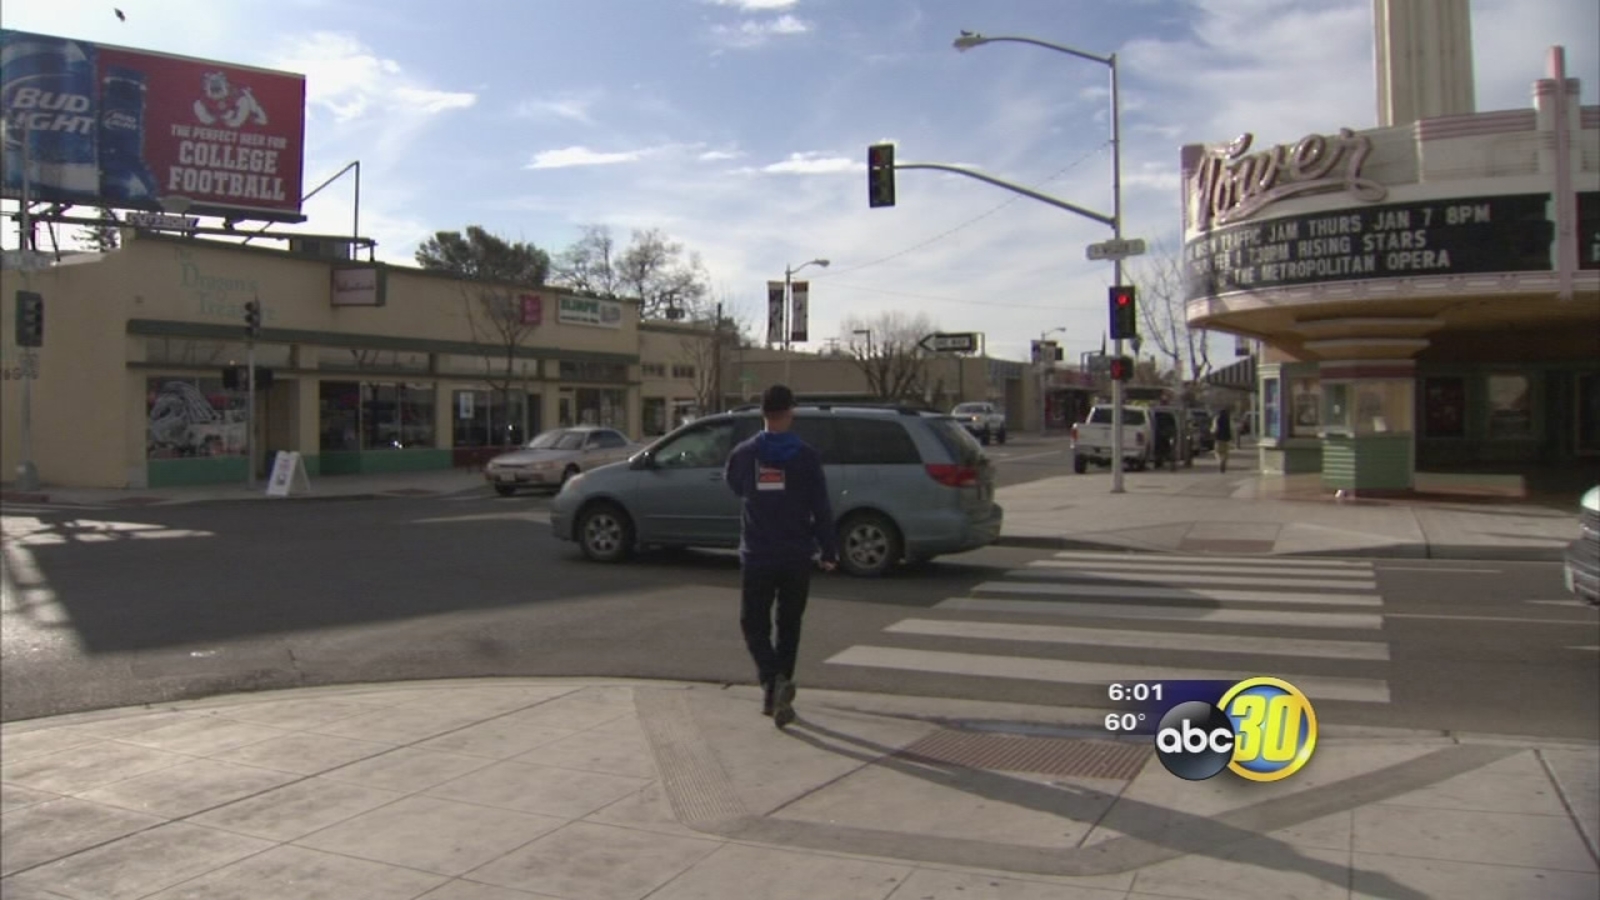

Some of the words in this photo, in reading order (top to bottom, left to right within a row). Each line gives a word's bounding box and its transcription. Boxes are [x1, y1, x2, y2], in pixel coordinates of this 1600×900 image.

[12, 87, 90, 113] BUD
[171, 124, 193, 138] THE
[193, 126, 237, 143] PERFECT
[267, 136, 287, 149] FOR
[180, 140, 278, 174] COLLEGE
[168, 166, 286, 201] FOOTBALL
[1187, 128, 1387, 230] Tower
[1268, 220, 1299, 244] JAM
[1308, 214, 1361, 237] THURS
[1374, 209, 1410, 231] JAN
[1423, 207, 1433, 226] 7
[1446, 203, 1491, 225] 8PM
[1298, 237, 1351, 258] RISING
[1364, 230, 1427, 251] STARS
[1261, 254, 1375, 282] METROPOLITAN
[1386, 249, 1450, 271] OPERA
